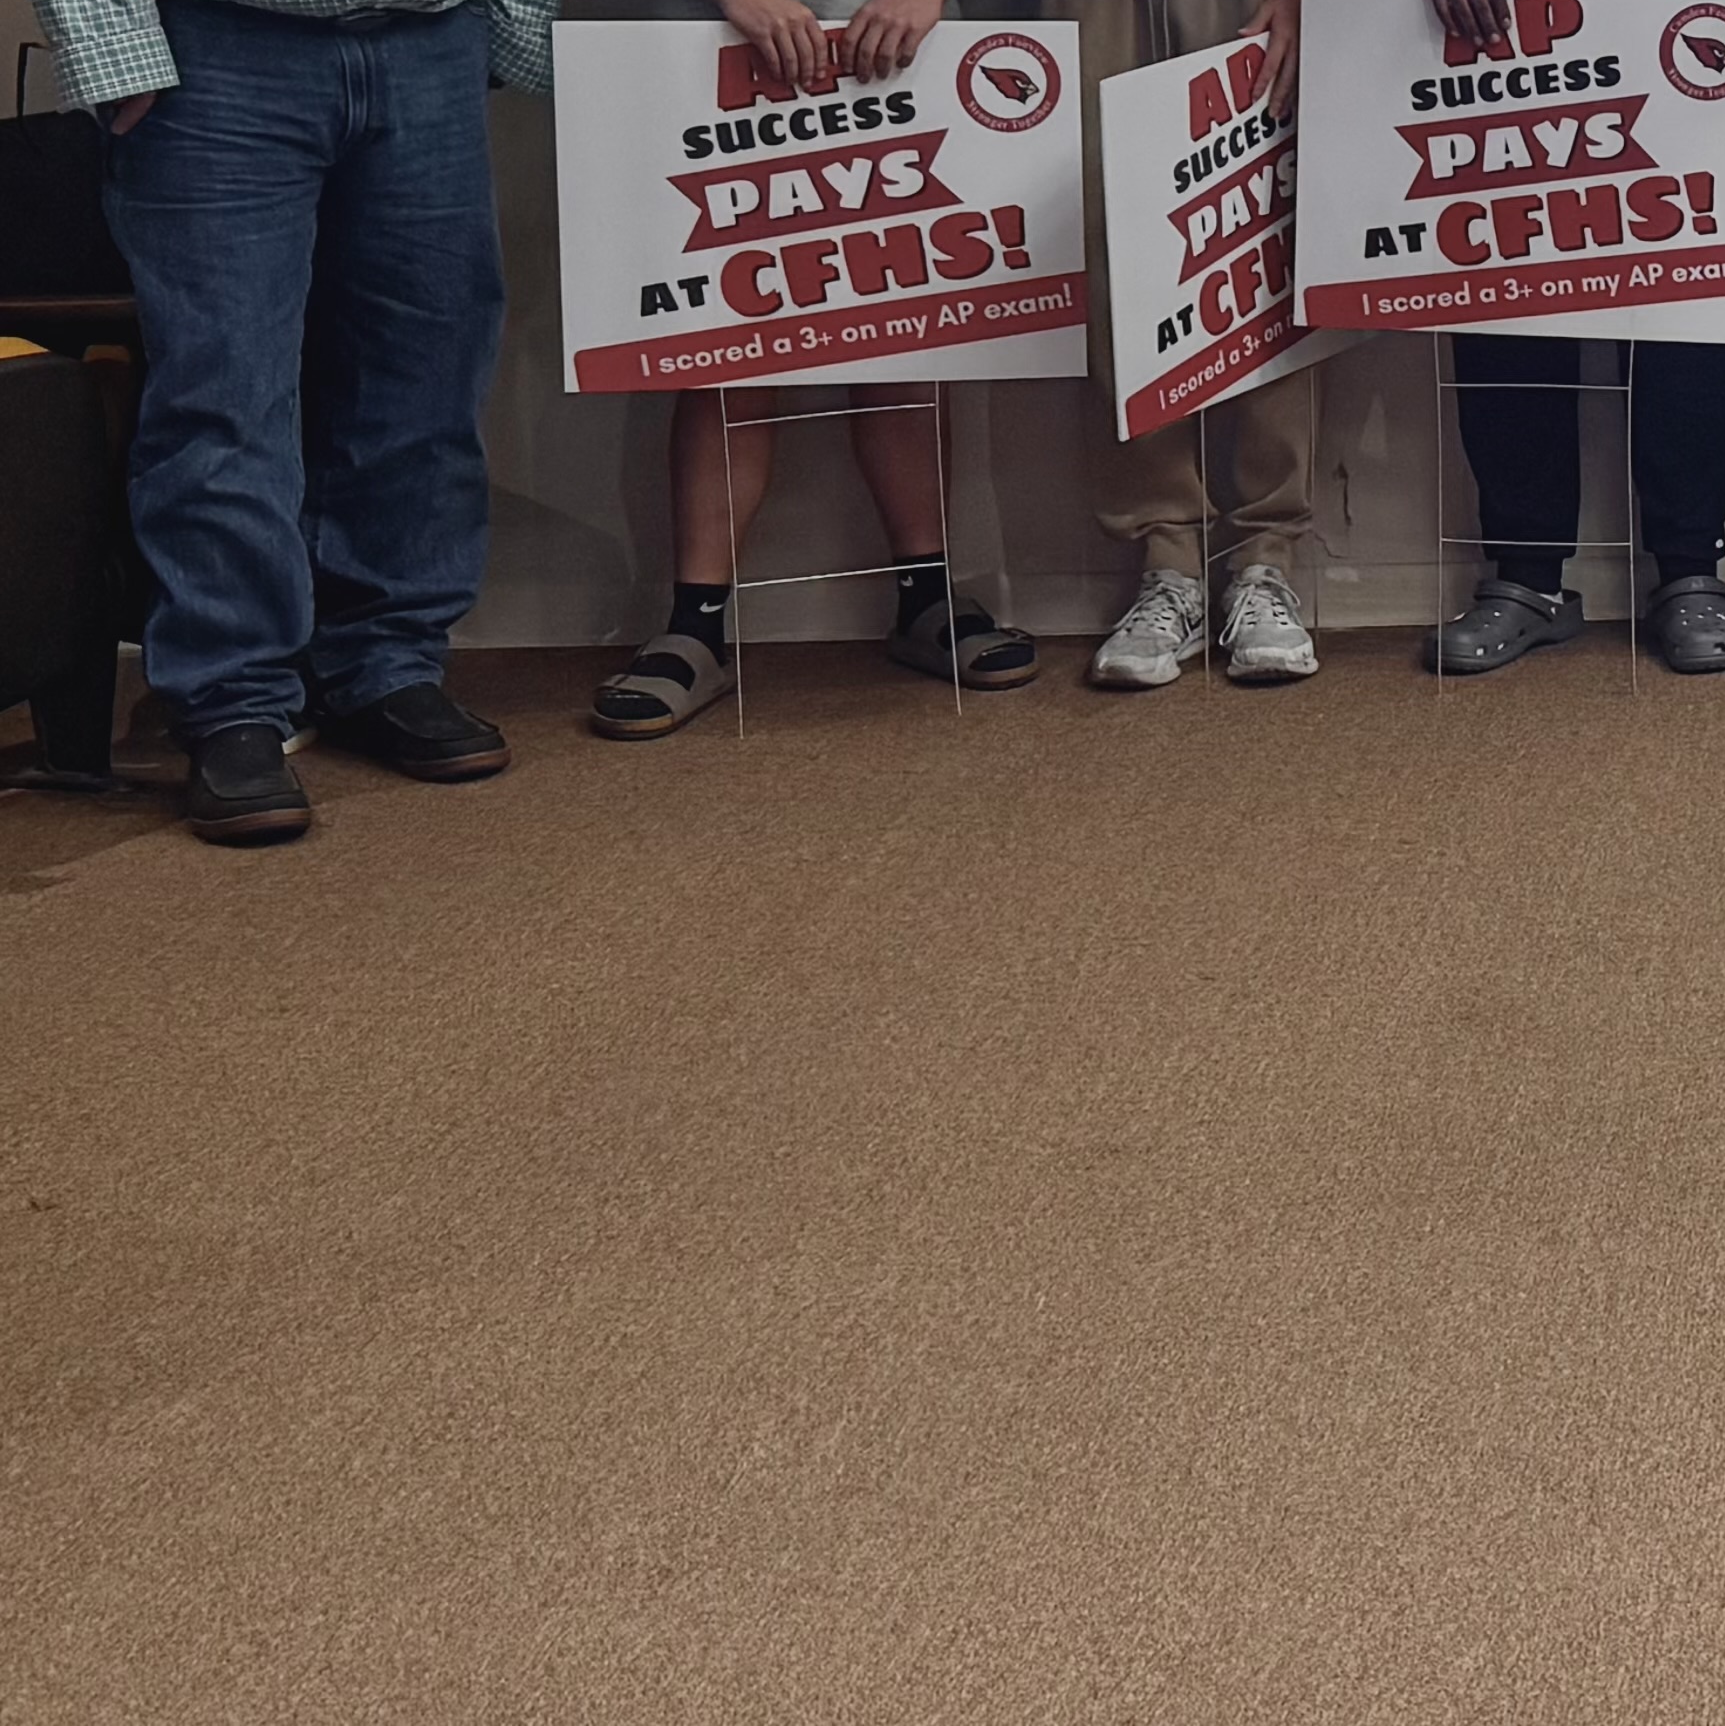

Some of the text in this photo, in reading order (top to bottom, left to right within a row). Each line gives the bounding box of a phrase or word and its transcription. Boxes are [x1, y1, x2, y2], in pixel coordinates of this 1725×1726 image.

[682, 91, 918, 159] SUCCESS
[1188, 42, 1267, 143] AP
[1409, 54, 1622, 112] SUCCESS
[704, 149, 927, 231] PAYS
[1426, 111, 1628, 181] PAYS
[1187, 148, 1297, 257] PAYS
[1363, 170, 1719, 266] AT CFHS!
[639, 204, 1032, 318] AT CFHS!
[1157, 223, 1295, 354] AT CFH
[1361, 293, 1371, 316] I
[1377, 281, 1472, 314] scored
[1479, 283, 1498, 303] a
[1503, 278, 1534, 303] 3+
[1540, 277, 1574, 298] on
[1581, 273, 1621, 299] my
[1628, 263, 1665, 288] AP
[639, 283, 1074, 378] I scored a 3+ on my AP exam!
[1158, 320, 1283, 411] I scored a 3+ on
